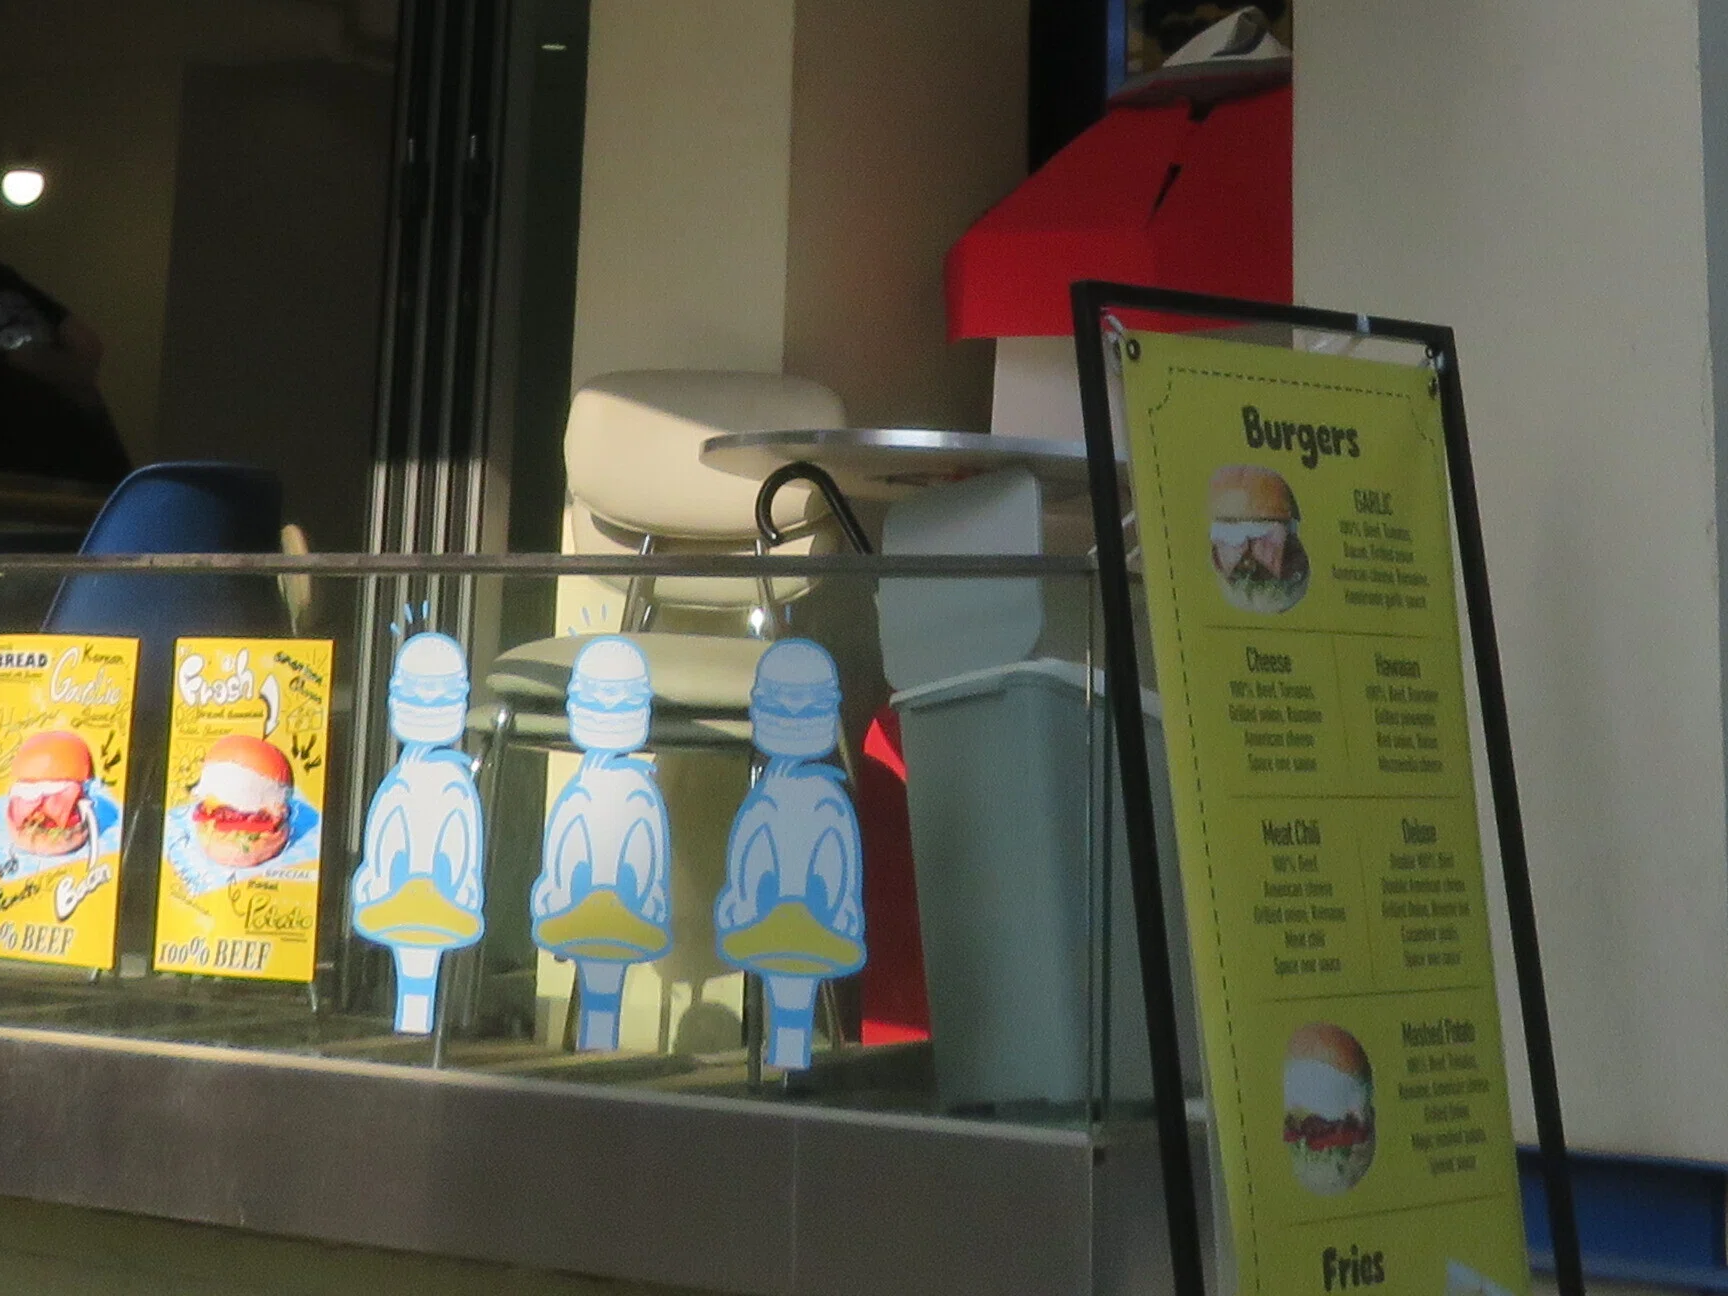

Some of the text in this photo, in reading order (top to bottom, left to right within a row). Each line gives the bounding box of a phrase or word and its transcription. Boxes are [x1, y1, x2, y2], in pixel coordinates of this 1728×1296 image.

[1241, 405, 1361, 470] Burgers
[1246, 645, 1293, 675] Cheese
[1261, 818, 1295, 846] Meat
[20, 924, 74, 956] BEEF
[158, 936, 272, 971] 100% BEEF
[1321, 1243, 1386, 1292] Fries
